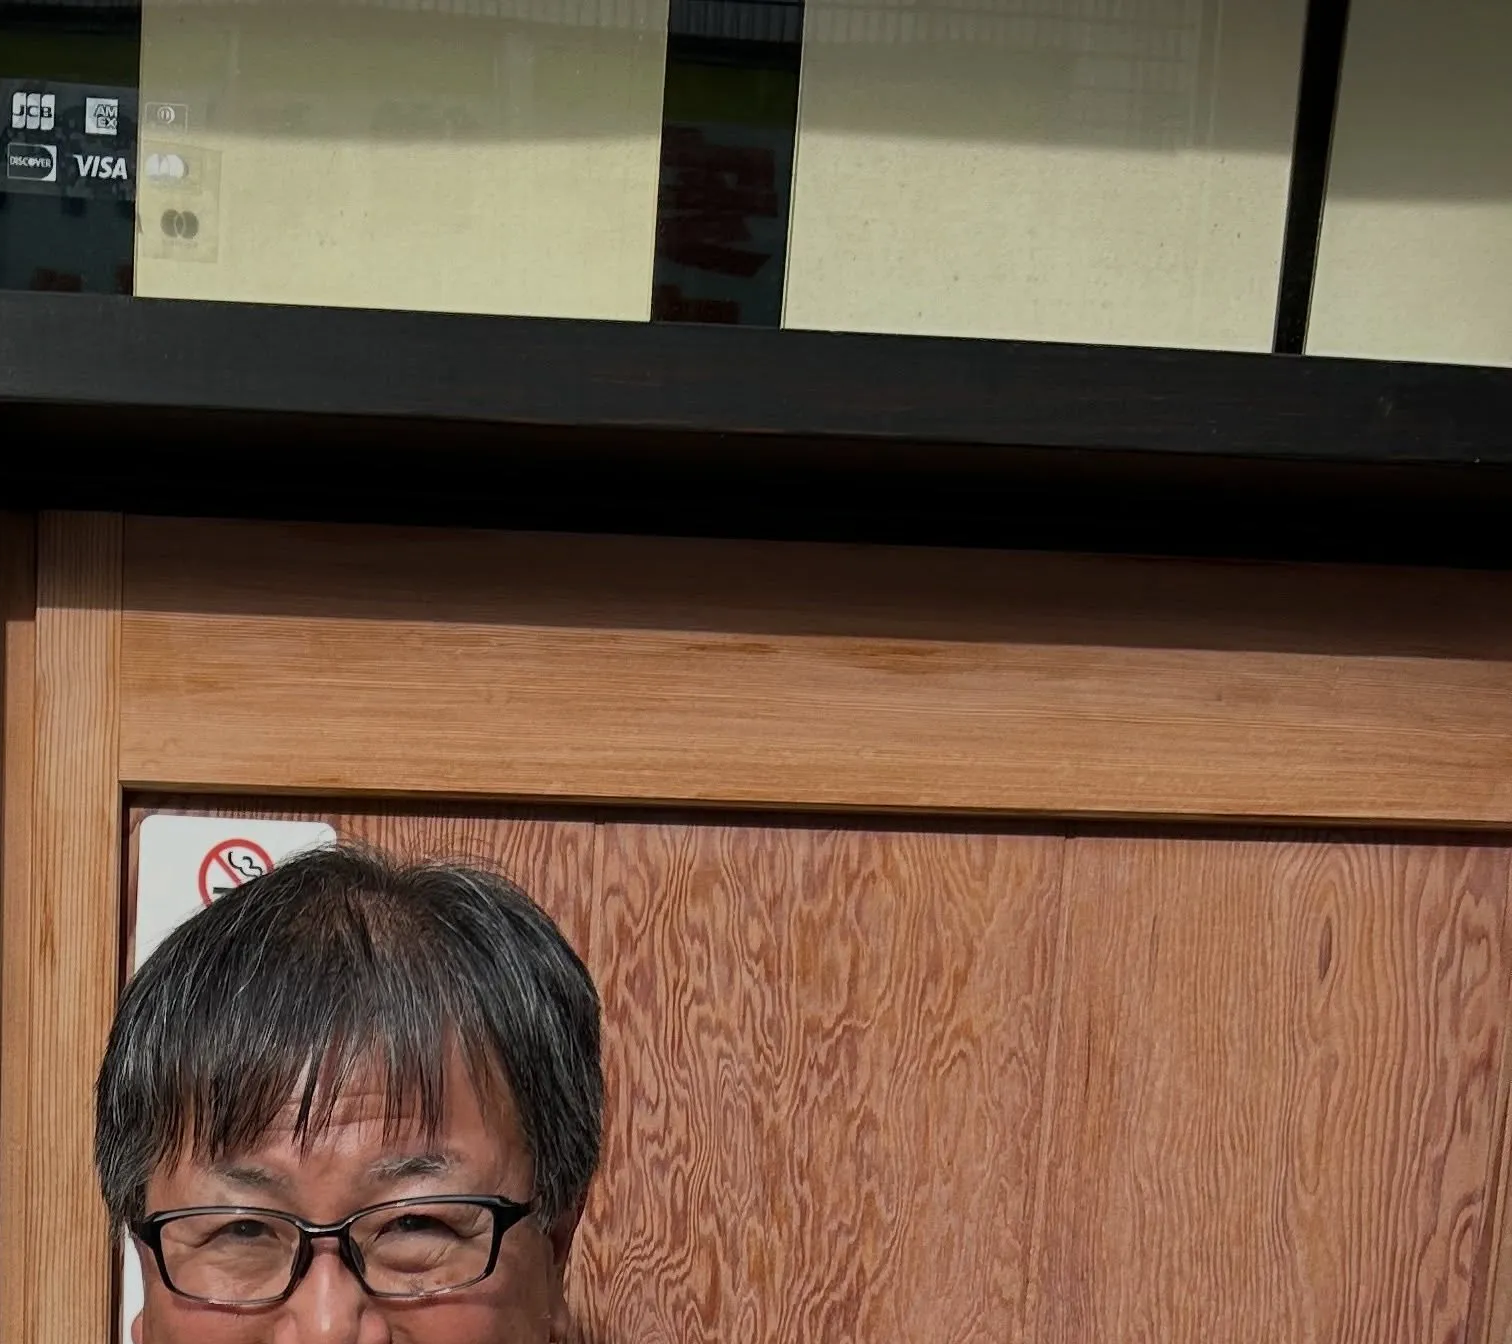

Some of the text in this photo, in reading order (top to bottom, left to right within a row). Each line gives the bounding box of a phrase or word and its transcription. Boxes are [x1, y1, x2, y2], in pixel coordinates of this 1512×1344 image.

[93, 103, 118, 117] AM
[96, 116, 118, 129] EX
[9, 155, 52, 168] DISCOVER
[72, 154, 128, 180] VISA
